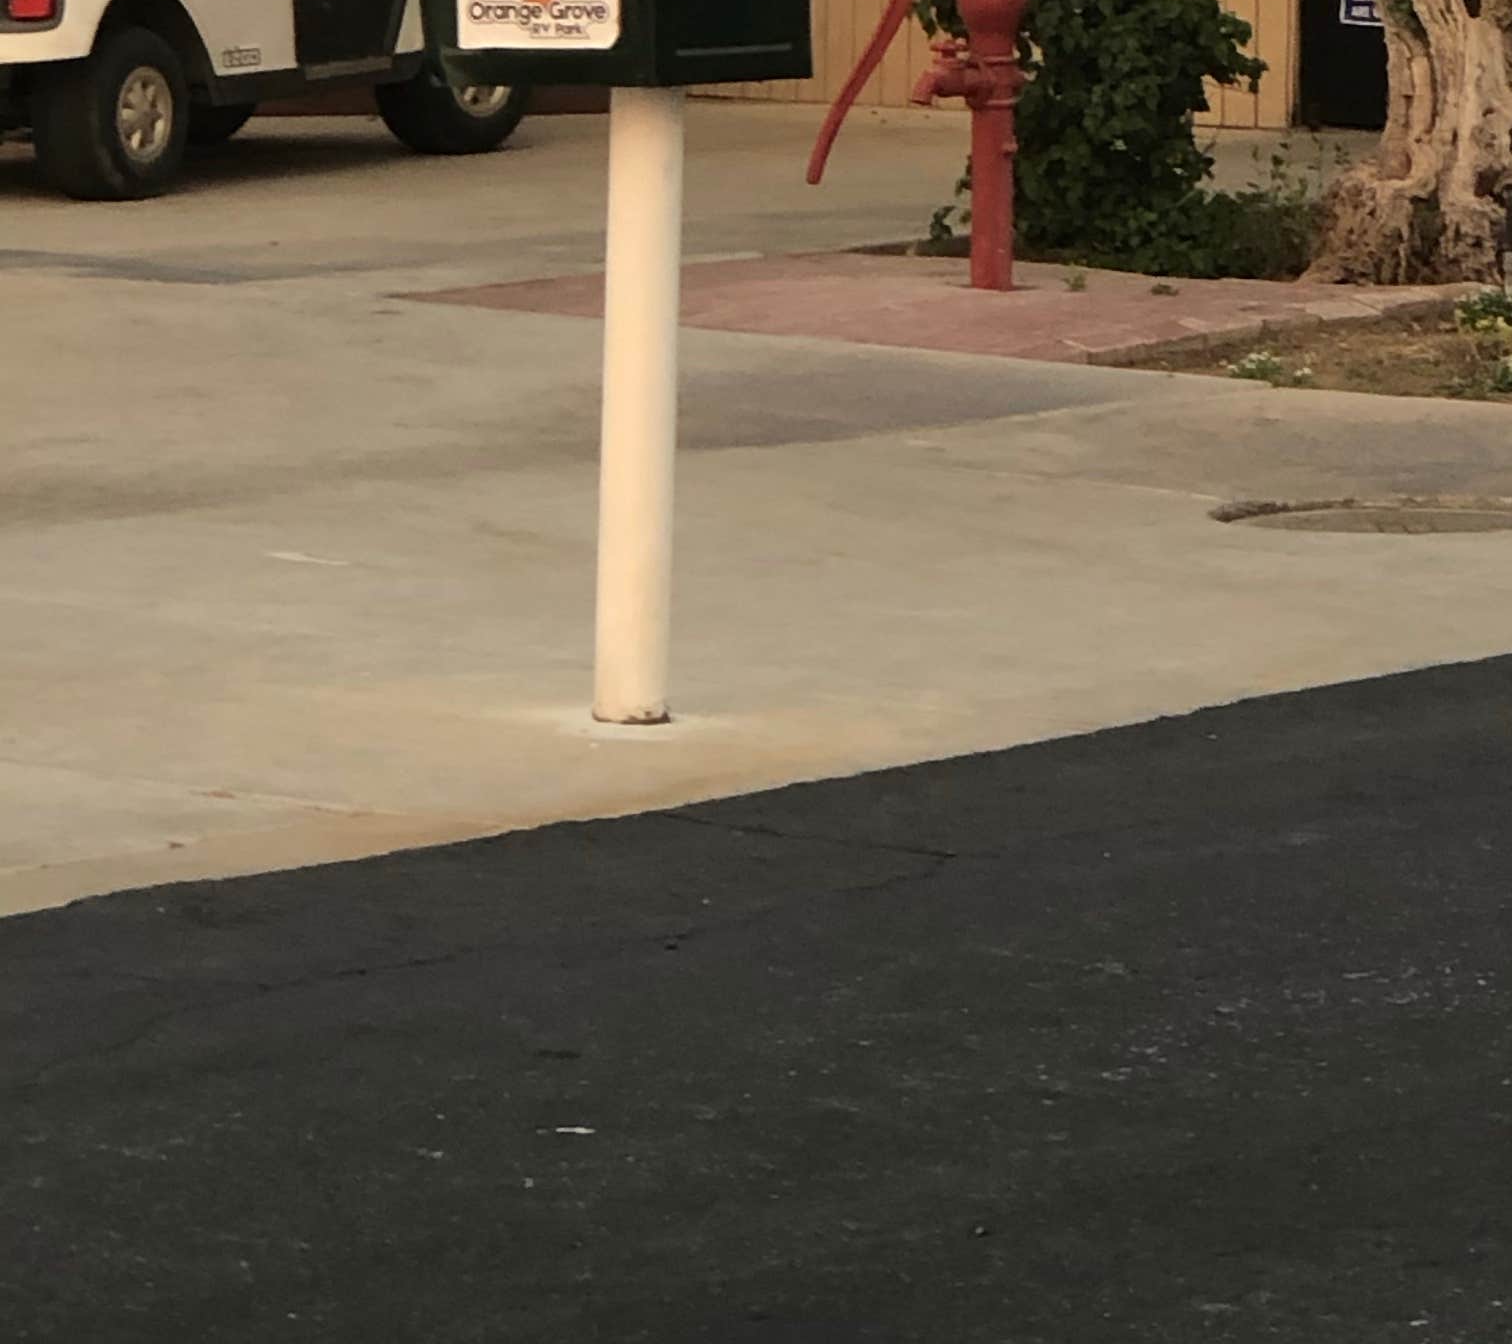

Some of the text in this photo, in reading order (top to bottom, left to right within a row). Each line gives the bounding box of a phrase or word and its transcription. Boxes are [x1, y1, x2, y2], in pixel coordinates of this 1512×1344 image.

[470, 1, 607, 25] Orange Grove
[533, 23, 582, 35] RV Park
